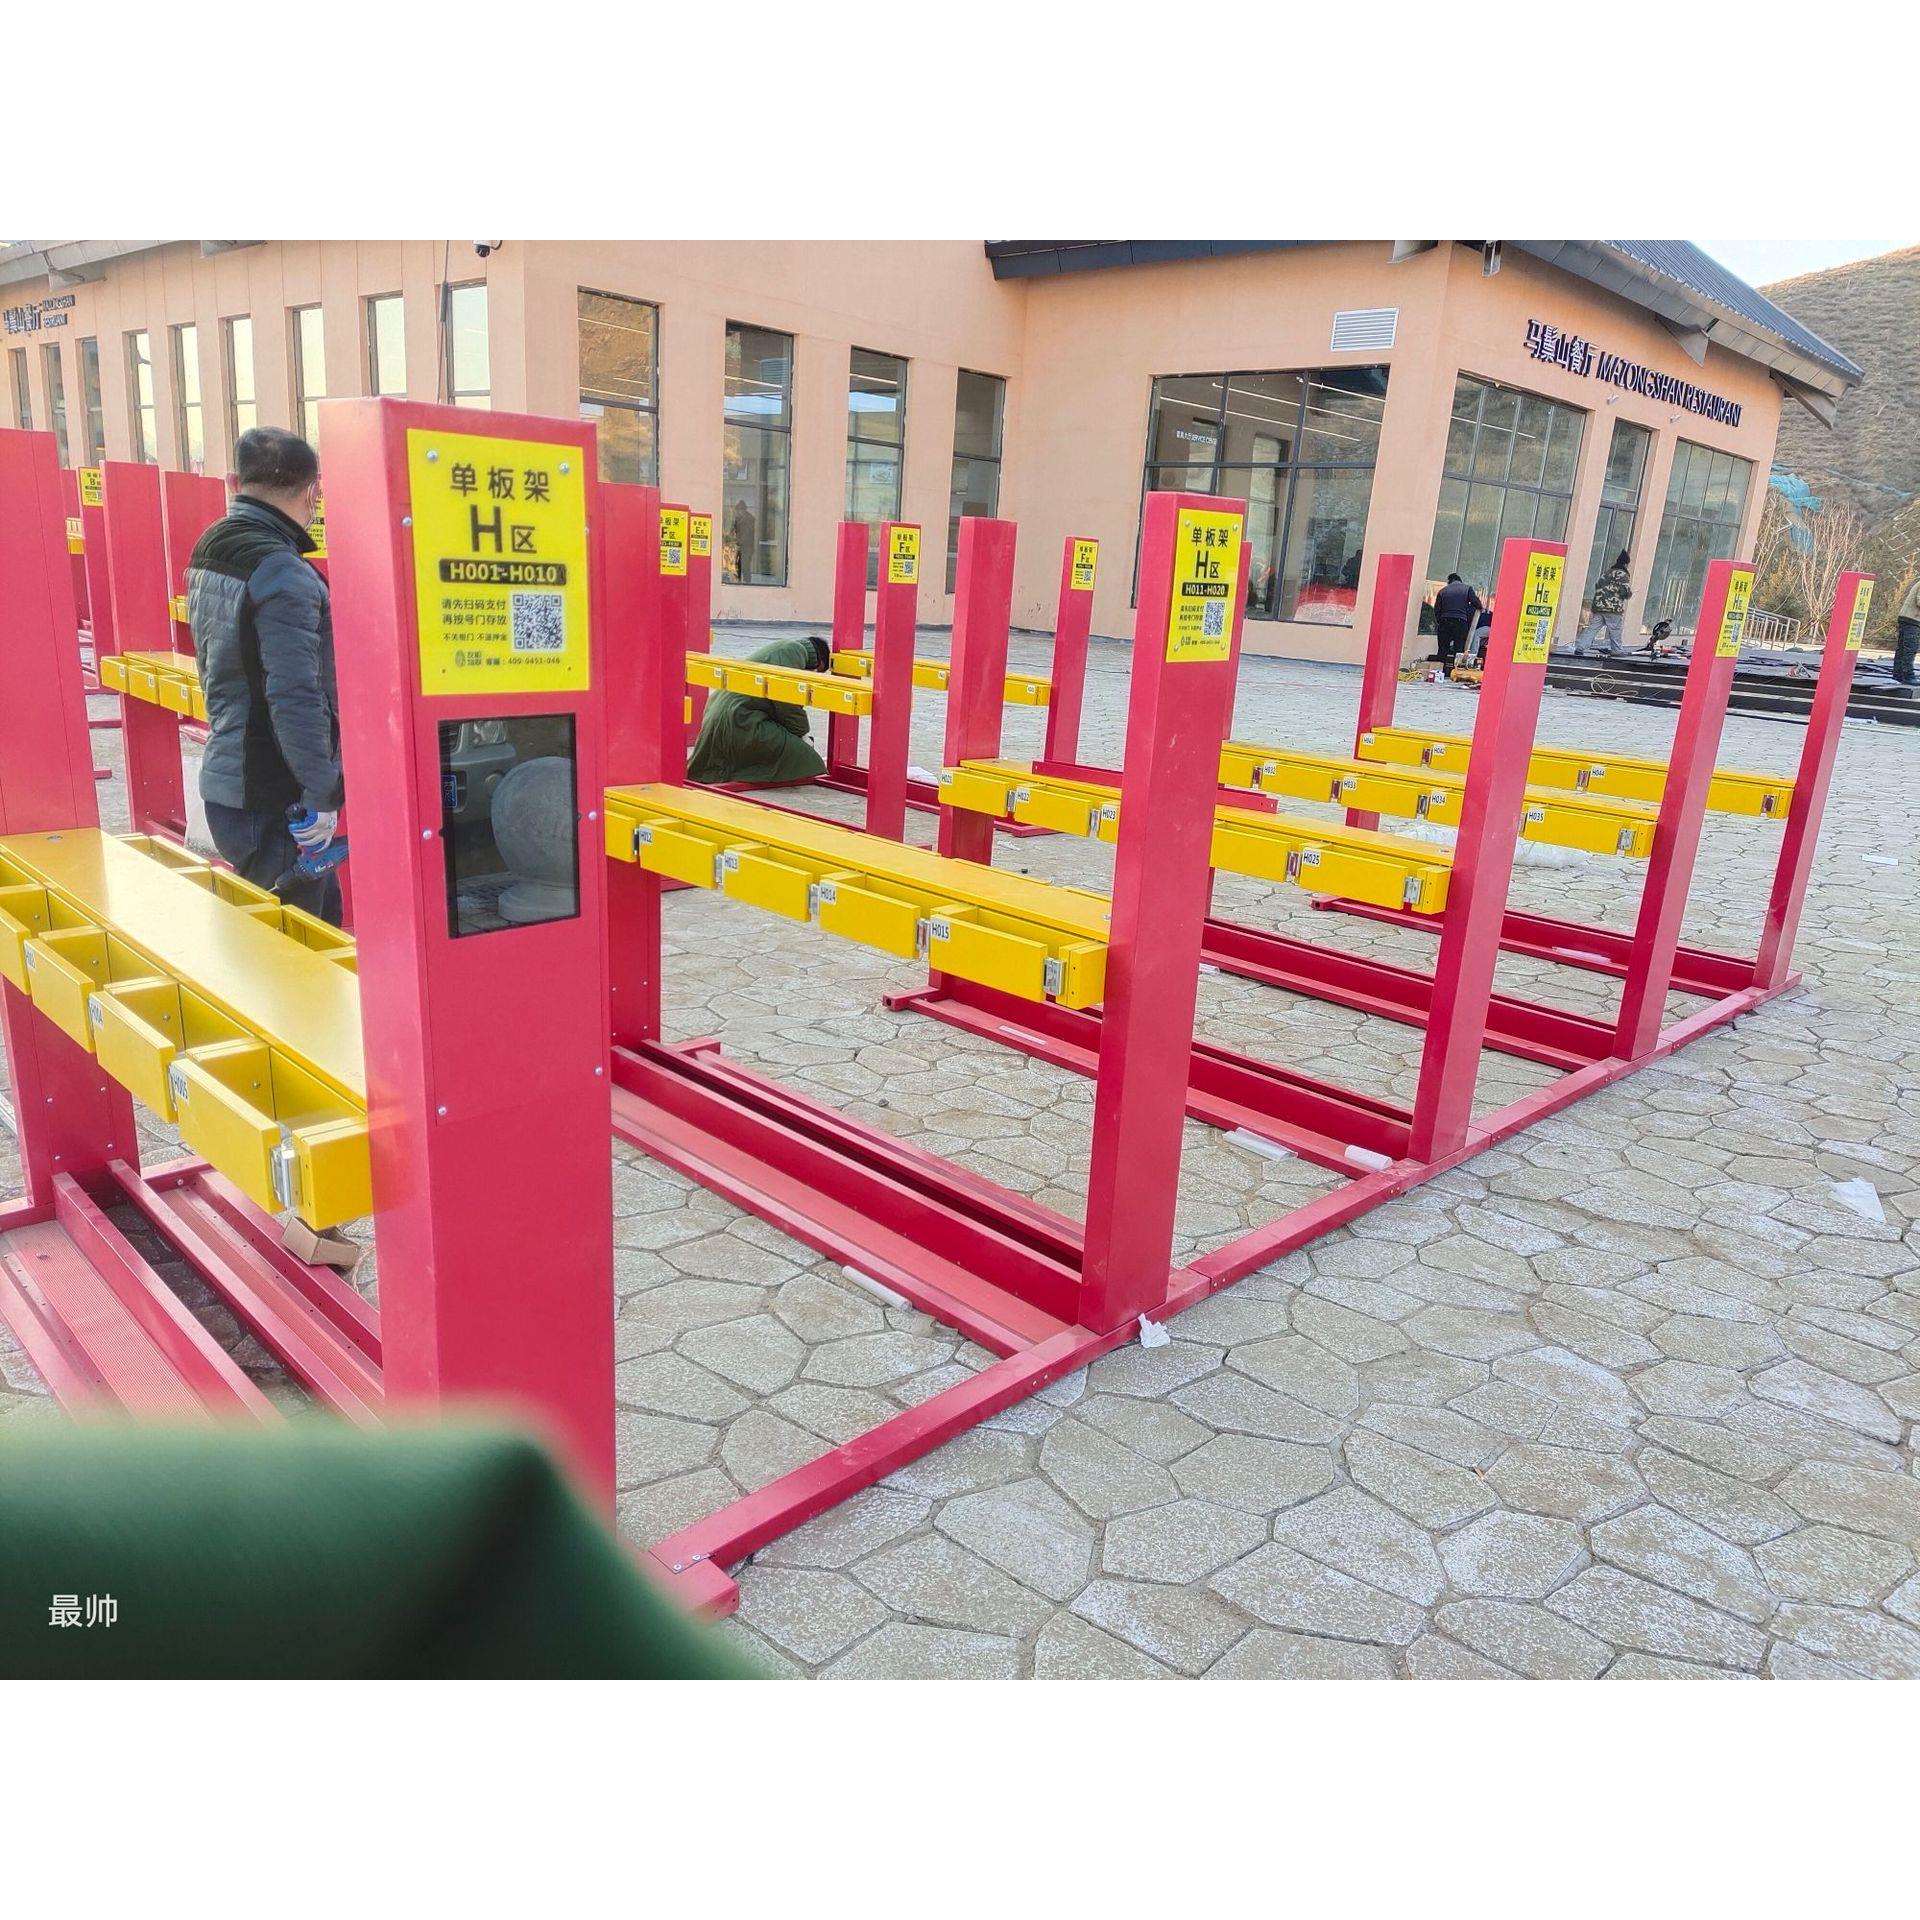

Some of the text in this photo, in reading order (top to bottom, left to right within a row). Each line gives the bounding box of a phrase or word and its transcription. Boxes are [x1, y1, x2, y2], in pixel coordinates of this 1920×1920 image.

[1596, 351, 1684, 406] MAZONGSHAN
[451, 462, 550, 502] 单板架
[470, 504, 537, 554] H区
[1192, 526, 1229, 548] 单板架
[450, 562, 557, 582] H001-H010
[1185, 584, 1226, 596] H011-H020
[1528, 811, 1544, 822] H035
[932, 922, 949, 940] H015
